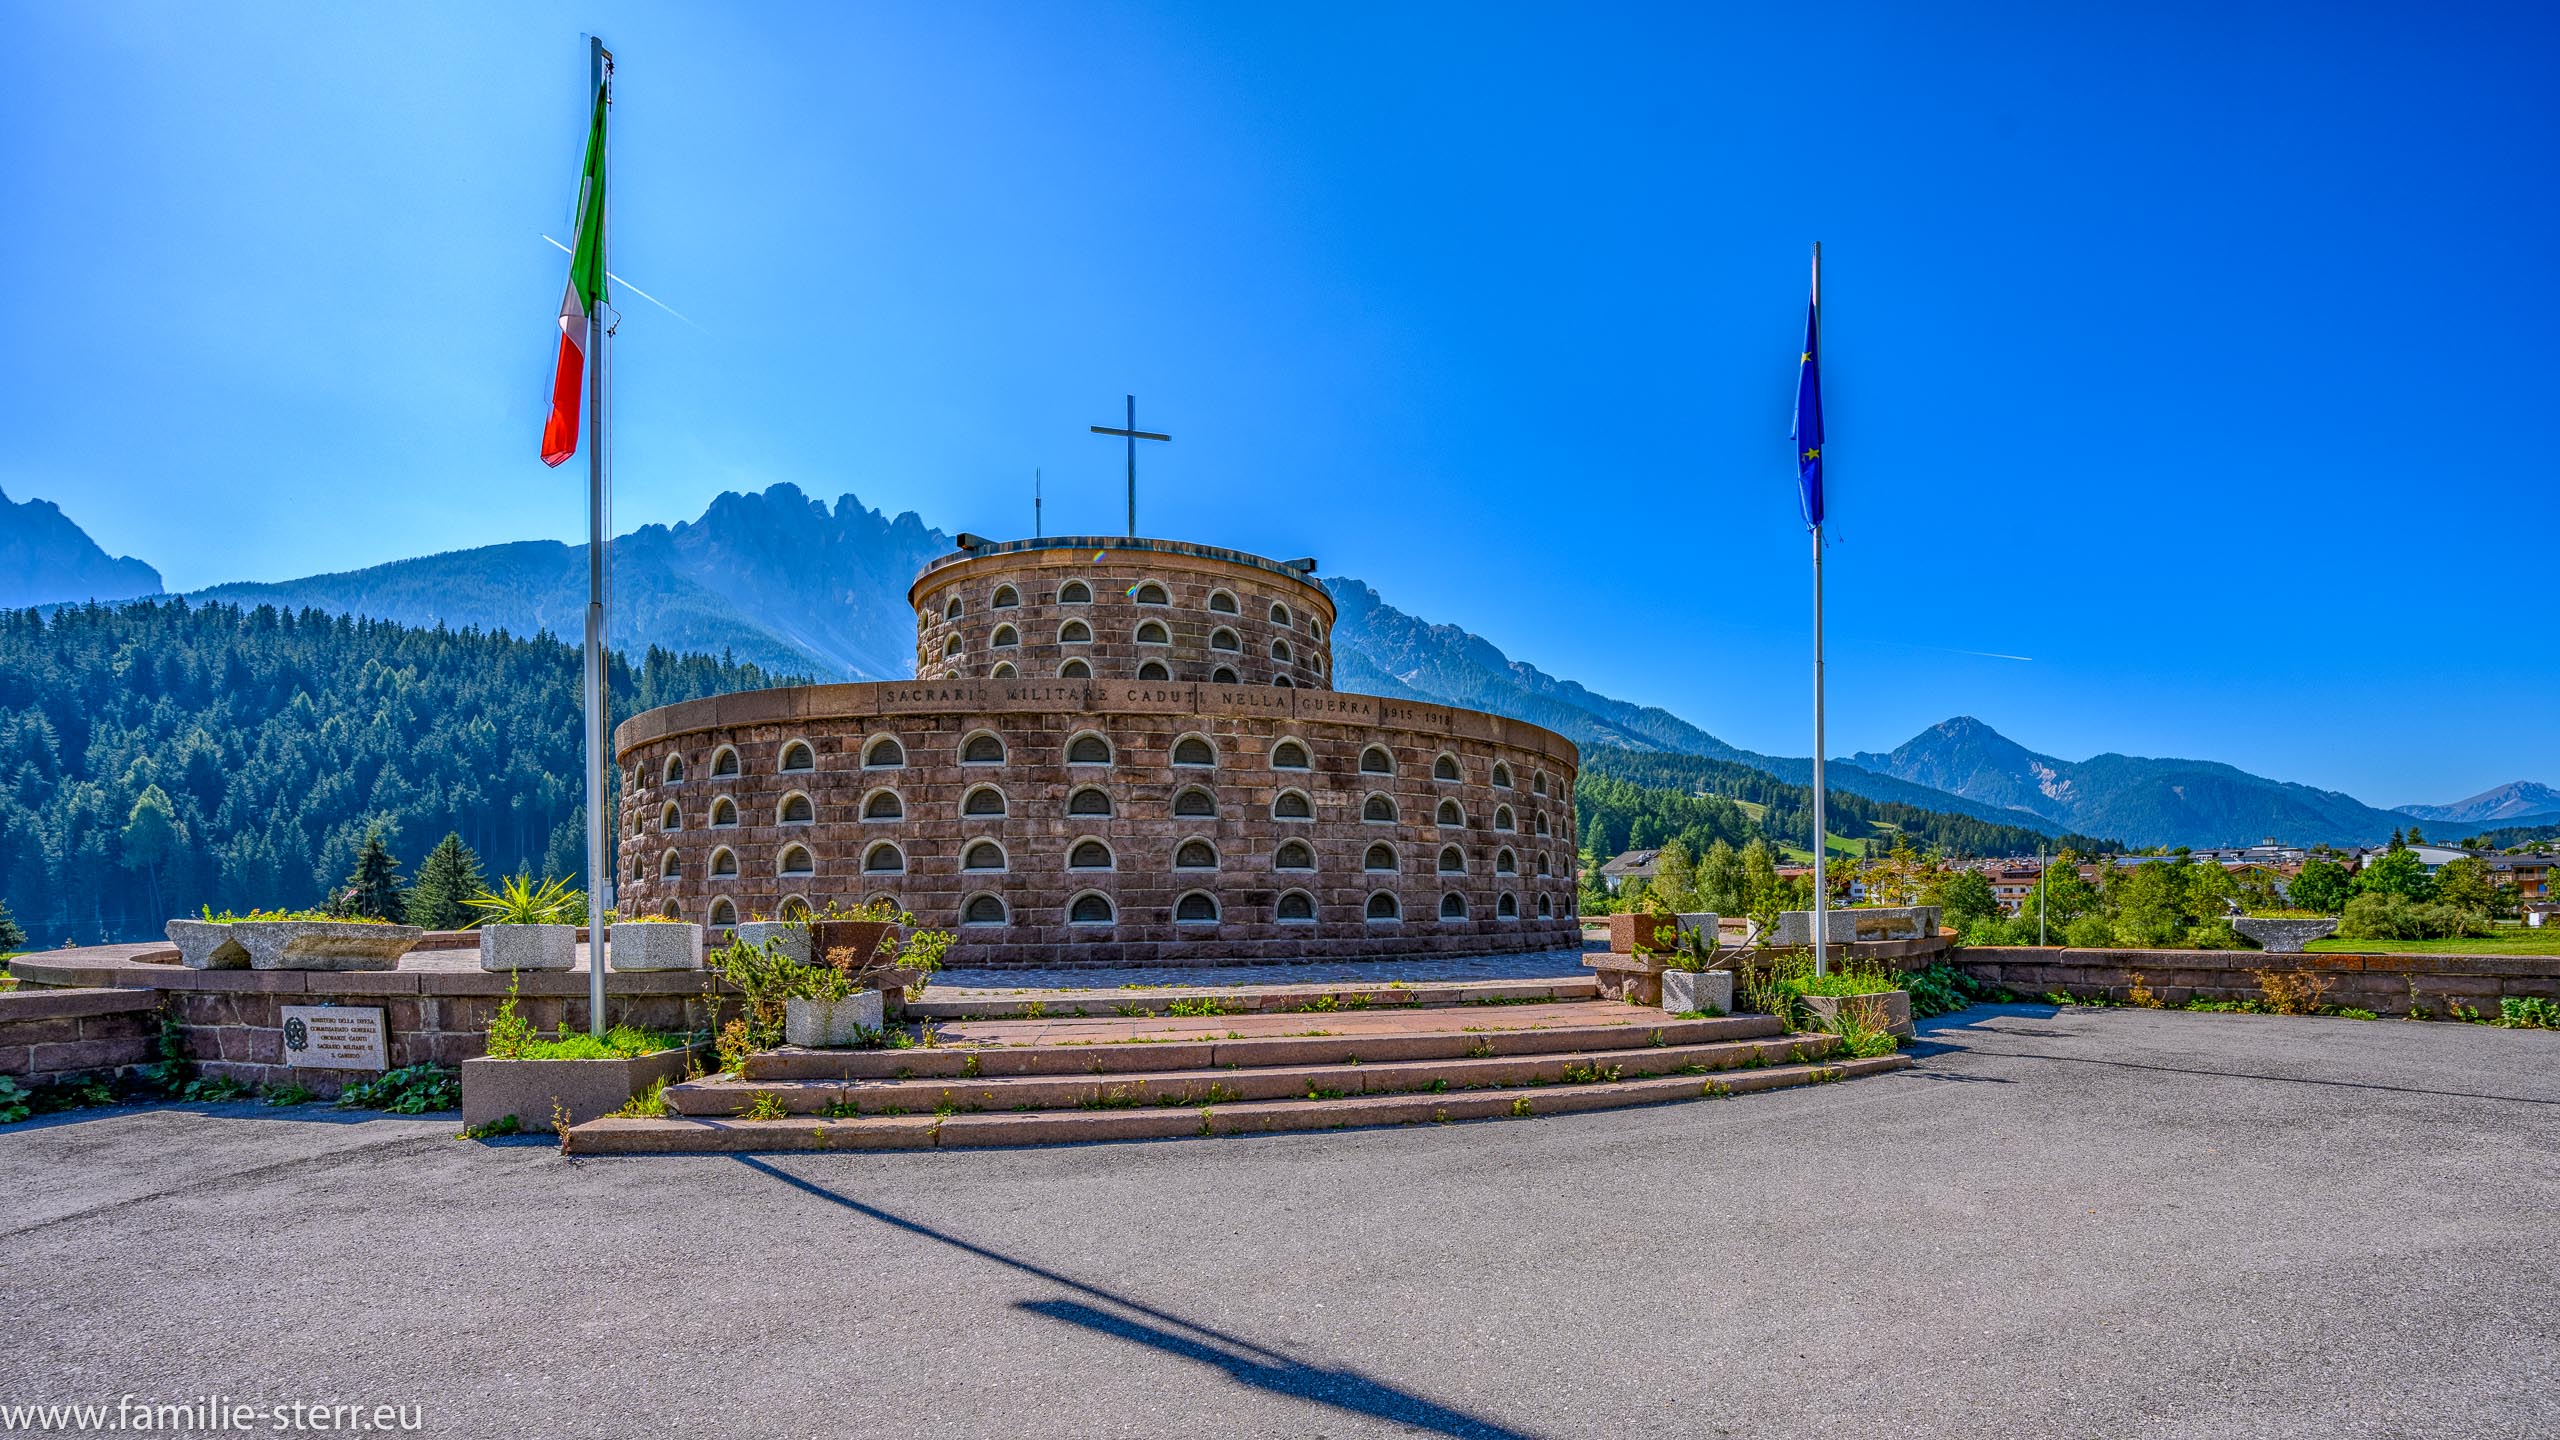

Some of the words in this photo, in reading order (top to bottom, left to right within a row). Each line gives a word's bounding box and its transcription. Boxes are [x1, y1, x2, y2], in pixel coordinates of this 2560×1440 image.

[886, 688, 988, 702] SACRARIO
[1006, 687, 1108, 701] MILITARE
[1127, 689, 1205, 704] CADUTI
[1222, 692, 1285, 708] NELLA
[1302, 699, 1370, 715] GUERRA
[1384, 707, 1413, 720] 1915
[1425, 712, 1450, 726] 1918
